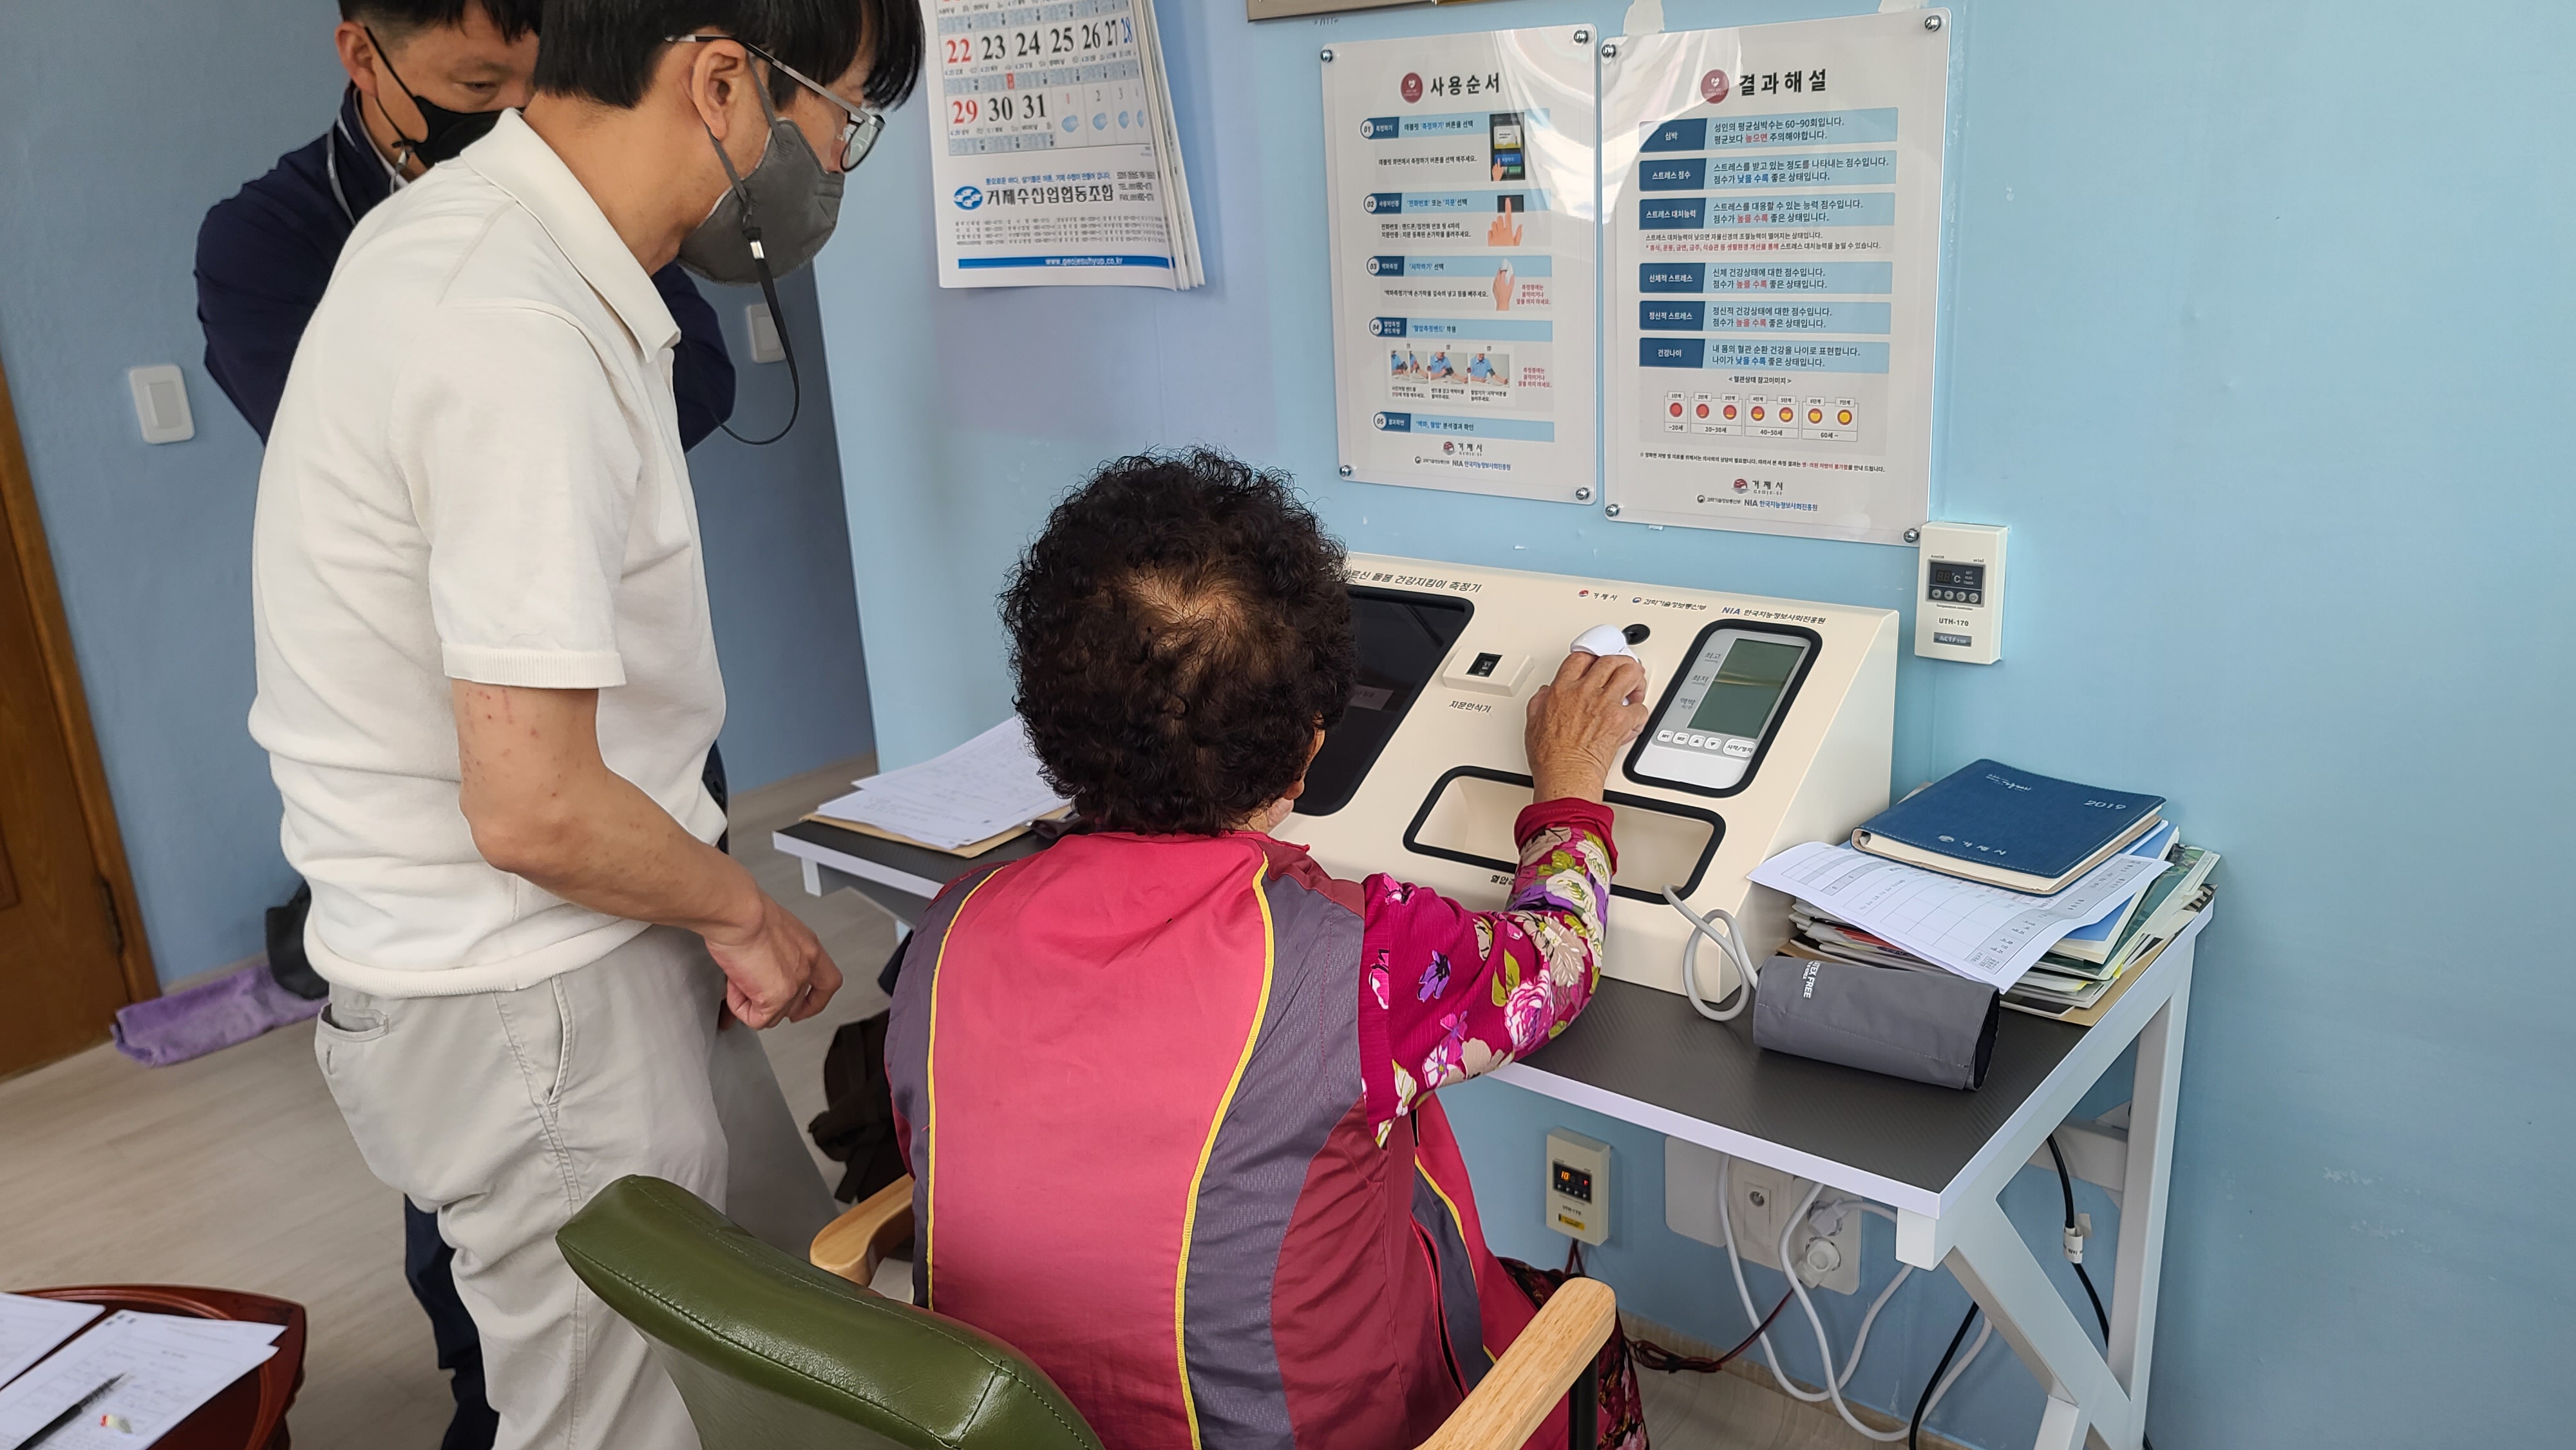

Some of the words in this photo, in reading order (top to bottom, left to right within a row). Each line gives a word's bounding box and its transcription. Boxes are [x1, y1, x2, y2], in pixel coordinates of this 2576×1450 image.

[946, 39, 972, 63] 22
[981, 35, 1006, 60] 23
[1016, 31, 1041, 57] 24
[1050, 27, 1074, 53] 25
[1082, 24, 1101, 50] 26
[1105, 19, 1117, 46] 27
[1121, 17, 1133, 43] 28
[1430, 73, 1499, 97] 사용순서
[1739, 69, 1826, 97] 결과해설
[952, 100, 978, 124] 29
[989, 97, 1012, 122] 30
[1023, 94, 1046, 120] 31
[1096, 89, 1101, 101] 2
[1714, 122, 1735, 133] 성인의
[1738, 120, 1783, 131] 평균심박수는
[1665, 132, 1678, 140] 심박
[1714, 134, 1743, 144] 평균보다
[1745, 133, 1767, 143] 높으면
[1770, 130, 1828, 142] 주의해야합니다.
[1714, 162, 1749, 173] 스트레스를
[1752, 162, 1766, 171] 받고
[1770, 161, 1784, 171] 있는
[1786, 160, 1810, 170] 정도를
[1812, 158, 1843, 169] 나타내는
[1846, 156, 1888, 167] 점수입니다.
[1652, 171, 1676, 180] 스트레스
[1678, 171, 1690, 179] 점수
[1714, 174, 1735, 184] 점수가
[1738, 174, 1752, 184] 낮을
[1754, 174, 1768, 183] 수록
[1771, 173, 1785, 183] 좋은
[1788, 171, 1830, 182] 상태입니다.
[987, 184, 1113, 205] 거제수산업협동조합
[1713, 202, 1749, 212] 스트레스를
[1752, 202, 1774, 211] 대응할
[1776, 202, 1783, 210] 수
[1786, 201, 1801, 210] 있는
[1803, 200, 1818, 210] 능력
[1821, 200, 1863, 209] 점수입니다.
[1713, 214, 1735, 224] 점수가
[1738, 214, 1751, 223] 높을
[1754, 214, 1768, 223] 수록
[1770, 214, 1785, 223] 좋은
[1788, 212, 1830, 222] 상태입니다.
[1713, 268, 1727, 277] 신체
[1729, 268, 1765, 277] 건강상태에
[1768, 268, 1783, 277] 대한
[1785, 268, 1825, 277] 점수입니다.
[1713, 280, 1734, 289] 점수가
[1736, 280, 1750, 288] 높을
[1753, 280, 1767, 288] 수록
[1770, 280, 1784, 288] 좋은
[1786, 279, 1828, 288] 상태입니다.
[1712, 307, 1734, 315] 정신적
[1736, 307, 1772, 315] 건강상태에
[1792, 308, 1833, 317] 점수입니다.
[1712, 318, 1734, 327] 점수가
[1769, 319, 1783, 328] 좋은
[1785, 319, 1826, 328] 상태입니다.
[1738, 345, 1751, 354] 혈관
[1754, 346, 1768, 354] 순환
[1770, 346, 1792, 355] 건강을
[1794, 346, 1816, 355] 나이로
[1819, 347, 1860, 356] 표현합니다.
[1712, 356, 1734, 364] 나이가
[1736, 357, 1749, 365] 낮을
[1752, 357, 1766, 366] 수록
[1785, 358, 1825, 367] 상태입니다.
[1759, 500, 1817, 511] 한국지능정보사회진흥원
[1372, 573, 1393, 583] 돌봄
[1395, 576, 1447, 588] 건강지킴이
[1448, 581, 1482, 593] 측정기
[1643, 599, 1707, 610] 과학기술정보통신부
[1721, 607, 1741, 615] NIA
[1743, 609, 1826, 625] 한국지능정보사회진흥원
[1939, 617, 1969, 626] UTH-170
[1449, 701, 1492, 713] 지문인식기
[1680, 697, 1696, 706] 맥박
[1727, 744, 1753, 753] 시작/정지
[2084, 800, 2126, 810] 2019
[1803, 977, 1815, 999] FREE
[1561, 1171, 1570, 1181] 10
